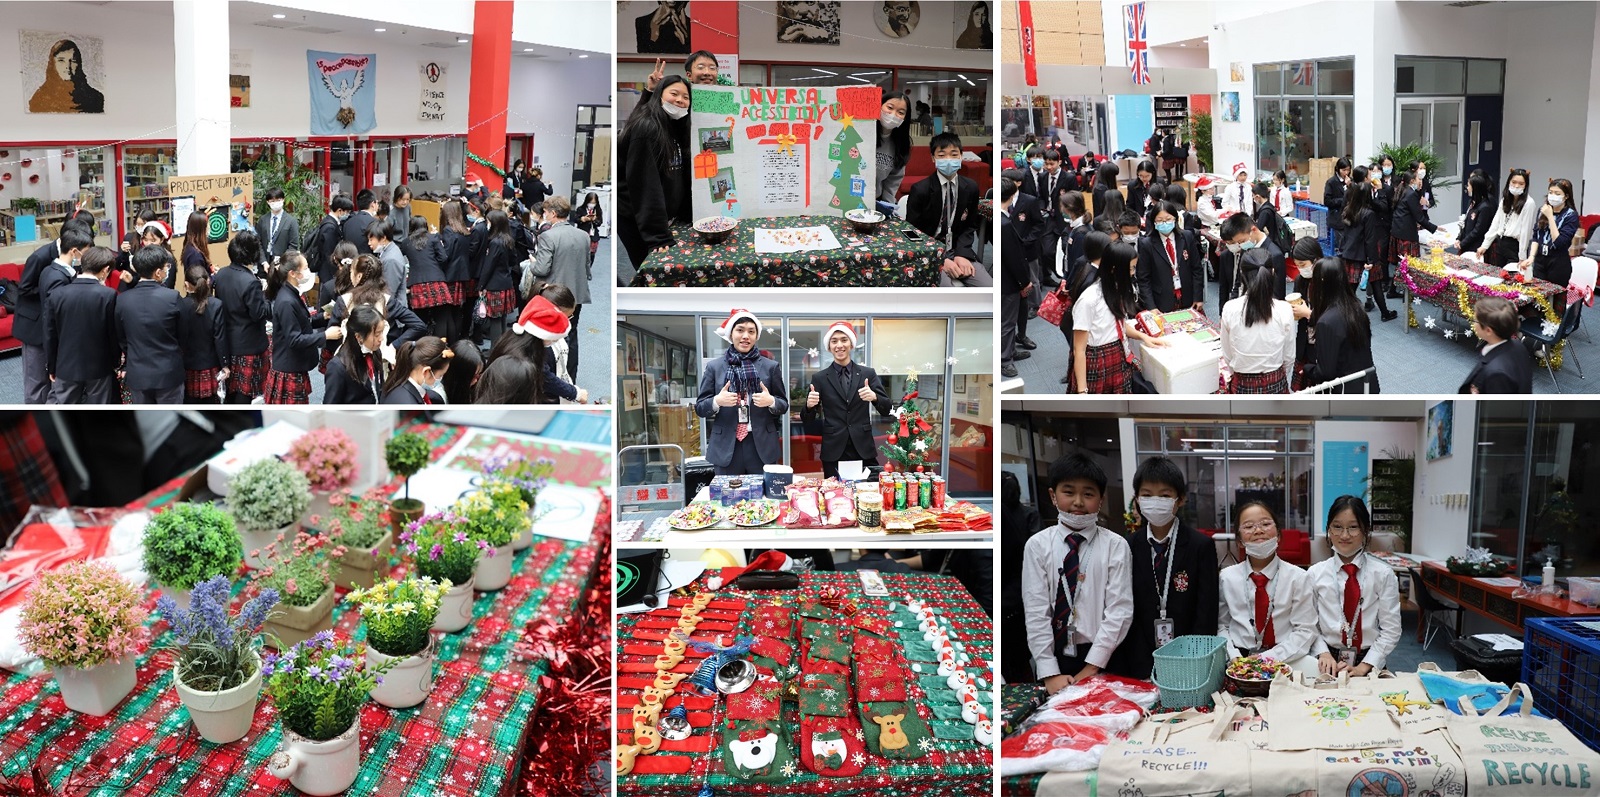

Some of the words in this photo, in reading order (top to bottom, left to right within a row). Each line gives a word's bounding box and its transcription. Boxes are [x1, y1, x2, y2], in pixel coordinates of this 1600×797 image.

[740, 88, 827, 105] UNIVERSAL
[741, 104, 828, 124] ACCESSIBILITY
[170, 178, 214, 193] PROJECT
[1480, 724, 1554, 744] REUSE
[1123, 747, 1197, 757] PEASE...
[1360, 749, 1385, 759] Do
[1393, 746, 1428, 758] not
[1141, 759, 1208, 772] RECYCLE!!!
[1325, 756, 1362, 764] eat
[1481, 758, 1591, 789] RECYCLE
